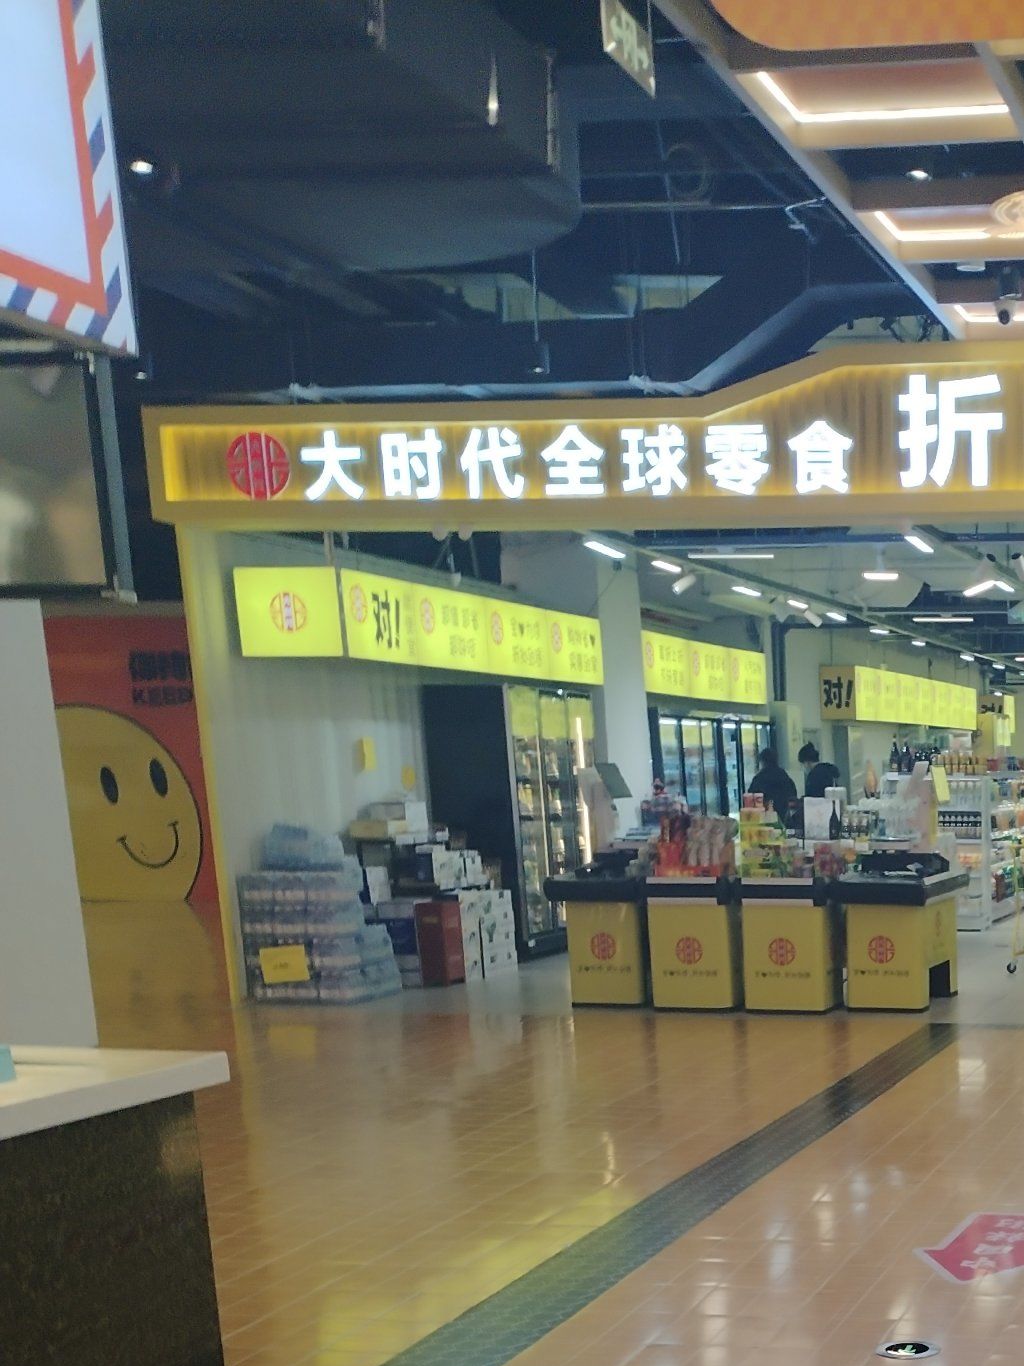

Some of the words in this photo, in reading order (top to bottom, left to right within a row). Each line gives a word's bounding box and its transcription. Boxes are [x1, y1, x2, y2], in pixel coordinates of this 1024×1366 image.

[300, 419, 854, 500] 大时代全球零食
[822, 675, 854, 709] 对!
